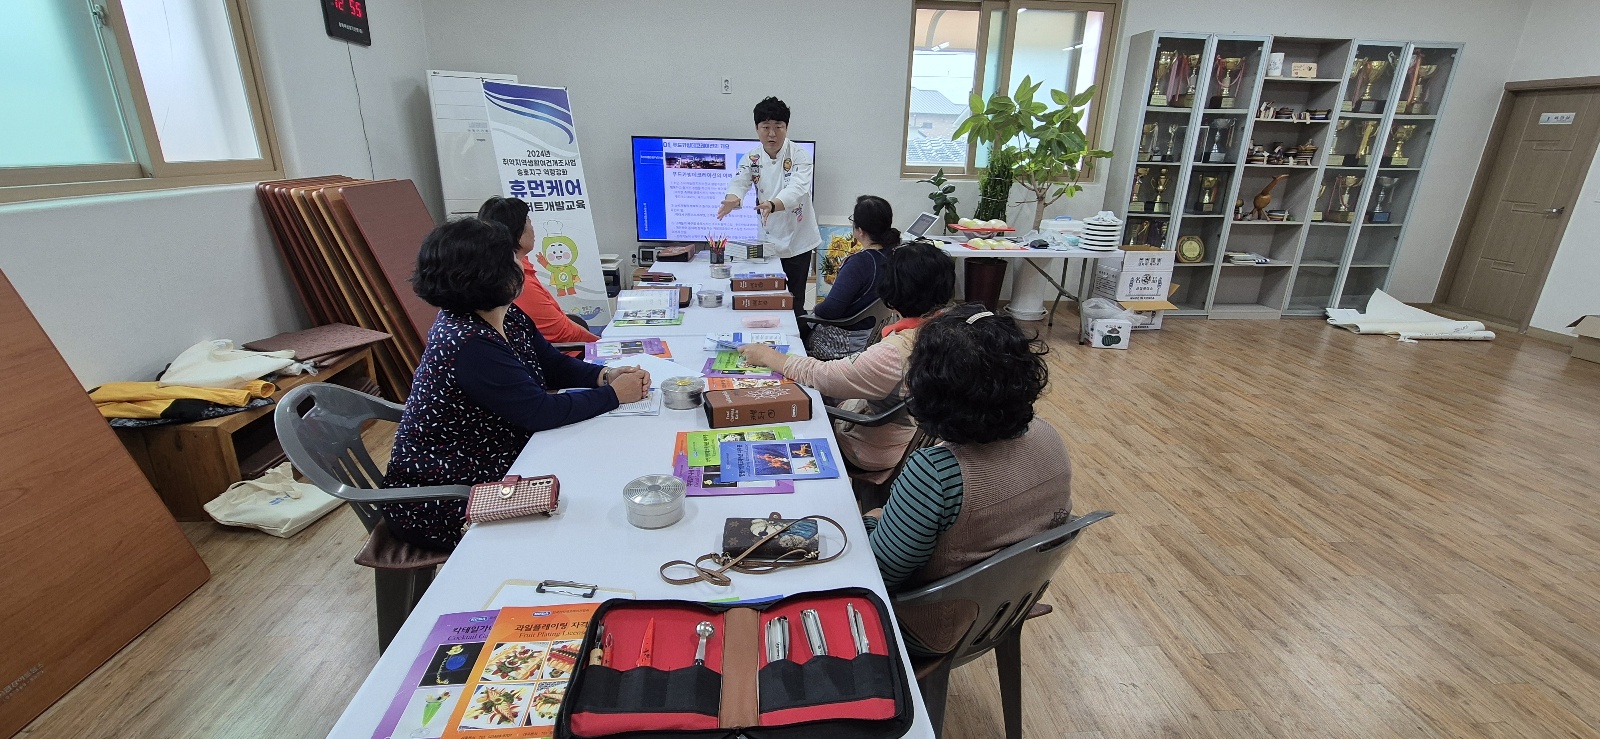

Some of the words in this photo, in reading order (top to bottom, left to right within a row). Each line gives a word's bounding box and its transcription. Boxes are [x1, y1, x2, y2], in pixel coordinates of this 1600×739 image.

[349, 0, 362, 18] 55
[526, 149, 551, 158] 2024년
[542, 168, 568, 176] 역량강화
[508, 178, 583, 198] 휴먼케어
[514, 621, 568, 632] 과일플레이팅
[570, 620, 589, 629] 자격
[447, 633, 478, 641] Cocktail
[536, 630, 561, 638] Plating
